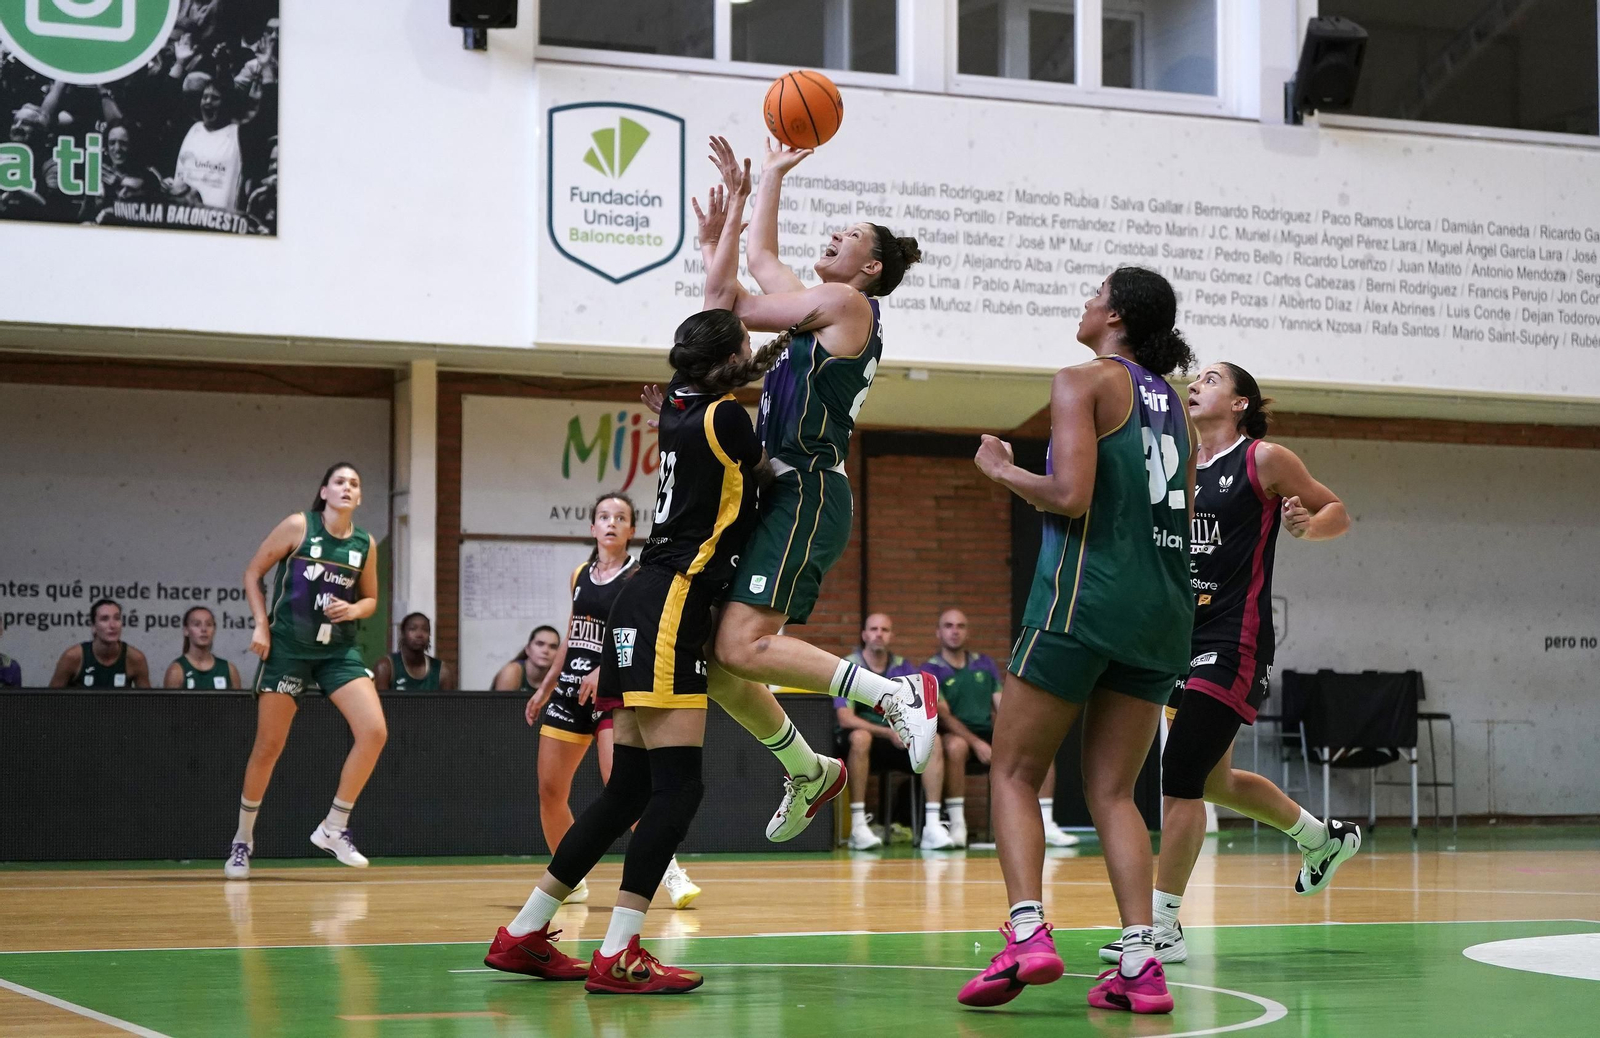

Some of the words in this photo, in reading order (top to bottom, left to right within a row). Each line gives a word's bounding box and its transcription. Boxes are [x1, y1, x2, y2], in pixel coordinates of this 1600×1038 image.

[53, 133, 102, 196] ti
[114, 201, 163, 223] UNICAJA
[166, 204, 248, 234] BALONCESTO
[569, 186, 662, 207] Fundación
[584, 208, 650, 232] Unicaja
[898, 181, 935, 196] Julián
[940, 183, 1003, 204] Rodríguez
[1015, 188, 1060, 206] Manolo
[1063, 192, 1099, 209] Rubia
[1111, 196, 1144, 212] Salva
[1148, 198, 1183, 215] Gallar
[1194, 201, 1248, 219] Bernardo
[1322, 210, 1351, 226] Paco
[1354, 212, 1393, 229] Ramos
[1397, 215, 1431, 231] Llorca
[1441, 217, 1483, 235] Damián
[1487, 221, 1529, 238] Caneda
[1540, 225, 1581, 242] Ricardo
[569, 227, 663, 247] Baloncesto
[810, 198, 852, 217] Miguel
[856, 201, 893, 218] Pérez
[903, 204, 949, 221] Alfonso
[953, 207, 995, 224] Portillo
[1006, 211, 1048, 228] Patrick
[1051, 213, 1116, 233] Fernández
[1126, 219, 1161, 236] Pedro
[1235, 226, 1270, 243] Muriel
[1280, 230, 1318, 248] Miguel
[1320, 228, 1353, 251] Ángel
[1356, 234, 1389, 251] Pérez
[1392, 237, 1417, 252] Lara
[1426, 239, 1463, 258] Miguel
[1466, 238, 1497, 260] Ángel
[1539, 246, 1562, 262] Lara
[1571, 248, 1597, 264] José
[918, 227, 958, 244] Rafael
[963, 231, 1004, 247] Ibáñez
[1016, 235, 1045, 250] José
[1069, 238, 1093, 253] Mur
[1104, 240, 1158, 257] Cristóbal
[1214, 247, 1250, 263] Pedro
[1253, 249, 1283, 266] Bello
[1293, 251, 1338, 269] Ricardo
[1341, 254, 1387, 272] Lorenzo
[1396, 258, 1424, 274] Juan
[1471, 263, 1514, 280] Antonio
[1516, 266, 1566, 284] Mendoza
[780, 243, 815, 257] anolo
[962, 253, 1021, 272] Alejandro
[1024, 256, 1052, 272] Alba
[1064, 259, 1113, 277] Germán
[1173, 266, 1206, 282] Manu
[1209, 267, 1252, 285] Gómez
[1263, 270, 1301, 288] Carlos
[1304, 273, 1355, 291] Cabezas
[1366, 277, 1395, 293] Berni
[1468, 283, 1508, 300] Francis
[1512, 286, 1547, 304] Perujo
[1558, 289, 1577, 304] Jon
[928, 273, 960, 290] Lima
[972, 276, 1009, 292] Pablo
[1012, 278, 1068, 295] Almazán
[1195, 288, 1227, 307] Pepe
[1231, 291, 1268, 308] Pozas
[1279, 293, 1321, 311] Alberto
[1363, 295, 1388, 315] Álex
[1391, 300, 1435, 317] Abrines
[1446, 303, 1470, 319] Luis
[1474, 304, 1511, 321] Conde
[1521, 307, 1554, 326] Dejan
[674, 281, 704, 297] Pabl
[888, 295, 926, 310] Lucas
[929, 296, 971, 313] Muñoz
[982, 299, 1022, 316] Rubén
[1026, 301, 1080, 319] Guerrero
[1183, 310, 1228, 327] Francis
[1229, 313, 1270, 330] Alonso
[1278, 316, 1323, 333] Yannick
[1325, 318, 1362, 335] Nzosa
[1372, 320, 1399, 337] Rafa
[1401, 321, 1440, 338] Santos
[1452, 324, 1485, 341] Mario
[1487, 326, 1560, 350] Saint-Supéry
[562, 410, 659, 494] Mija
[46, 579, 83, 602] qué
[89, 582, 151, 602] puede
[157, 582, 211, 600] hacer
[570, 620, 606, 645] EVILL
[1545, 635, 1576, 652] pero
[1580, 636, 1598, 649] no
